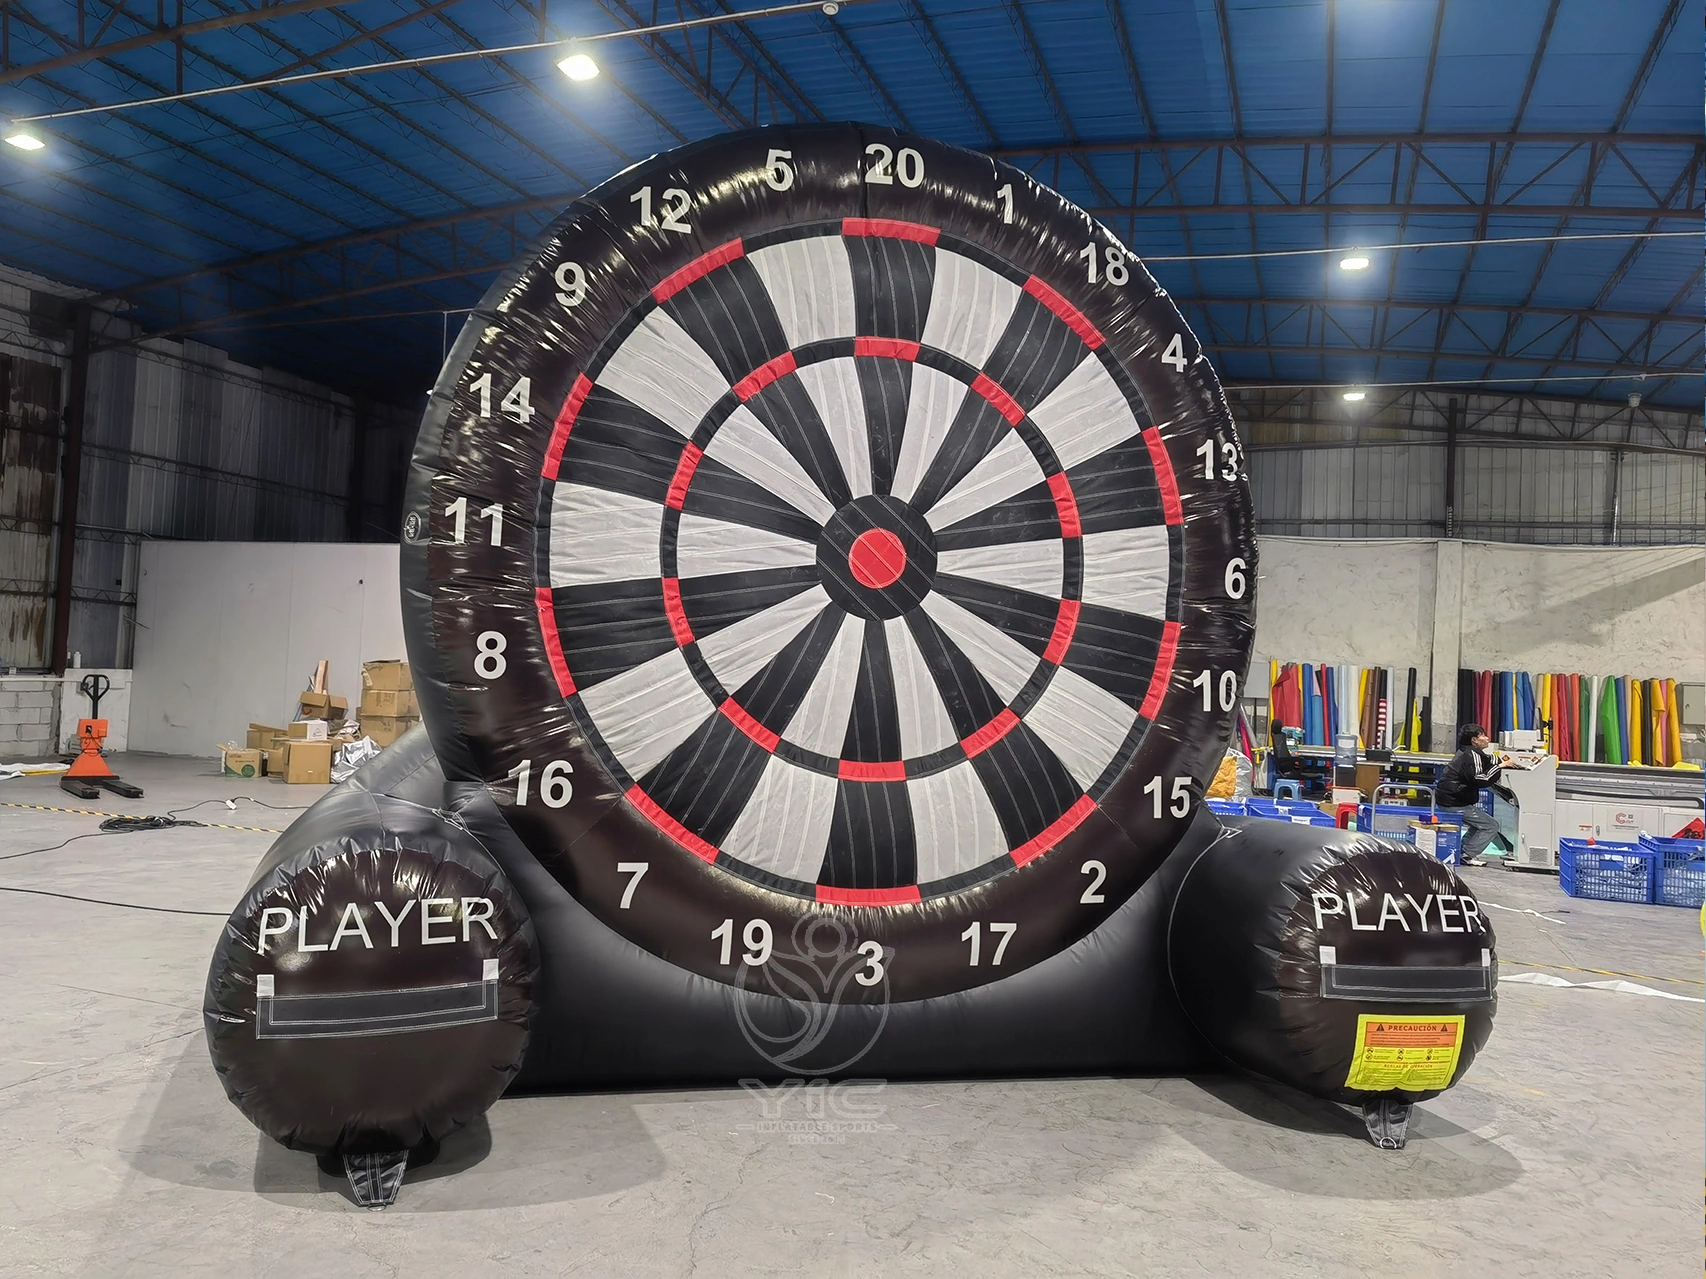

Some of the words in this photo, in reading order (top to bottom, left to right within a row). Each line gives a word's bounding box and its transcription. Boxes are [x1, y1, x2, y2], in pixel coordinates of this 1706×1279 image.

[765, 149, 793, 191] 5
[864, 143, 925, 188] 20
[630, 186, 692, 234] 12
[996, 183, 1013, 224] 1
[554, 261, 586, 306] 9
[1080, 242, 1129, 287] 18
[1161, 333, 1188, 373] 4
[470, 373, 535, 424] 14
[1196, 439, 1237, 481] 13
[445, 497, 504, 546] 11
[1224, 558, 1247, 599] 6
[473, 631, 507, 680] 8
[1193, 670, 1237, 712] 10
[507, 759, 574, 808] 16
[1144, 775, 1192, 819] 15
[616, 862, 649, 909] 7
[1080, 860, 1107, 904] 2
[256, 896, 499, 956] PLAYER
[1311, 892, 1487, 933] PLAYER
[710, 918, 774, 966] 19
[855, 940, 885, 986] 3
[961, 921, 1018, 966] 17
[1388, 1024, 1437, 1032] PRECAUCIÓN
